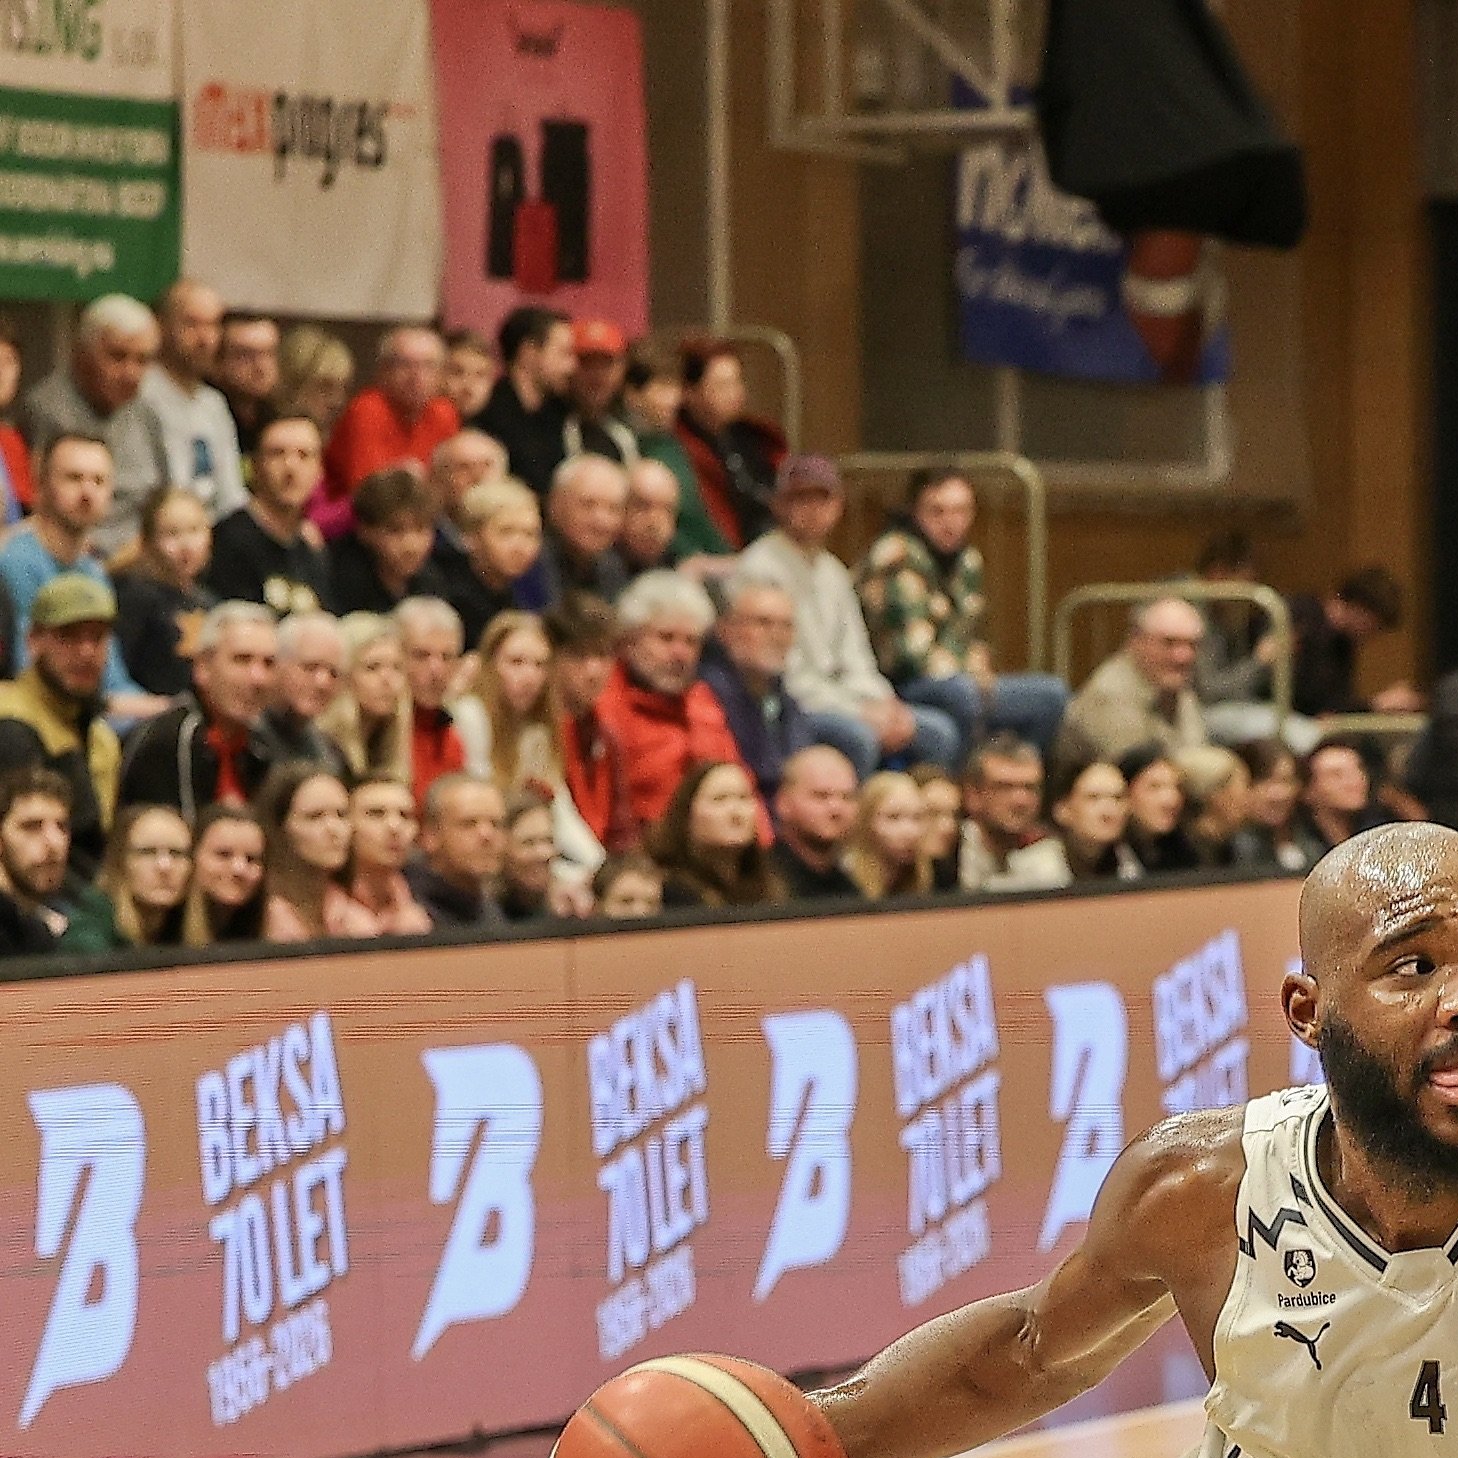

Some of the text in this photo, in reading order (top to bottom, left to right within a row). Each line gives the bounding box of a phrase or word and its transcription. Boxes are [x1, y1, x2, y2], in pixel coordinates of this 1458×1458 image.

[196, 1008, 348, 1204] BEKSA
[587, 977, 708, 1158] BEKSA
[890, 952, 1000, 1121] BEKSA
[209, 1147, 350, 1345] 70 LET
[646, 1103, 711, 1255] LET
[1277, 1291, 1337, 1309] Pardubice
[1409, 1359, 1448, 1435] 4
